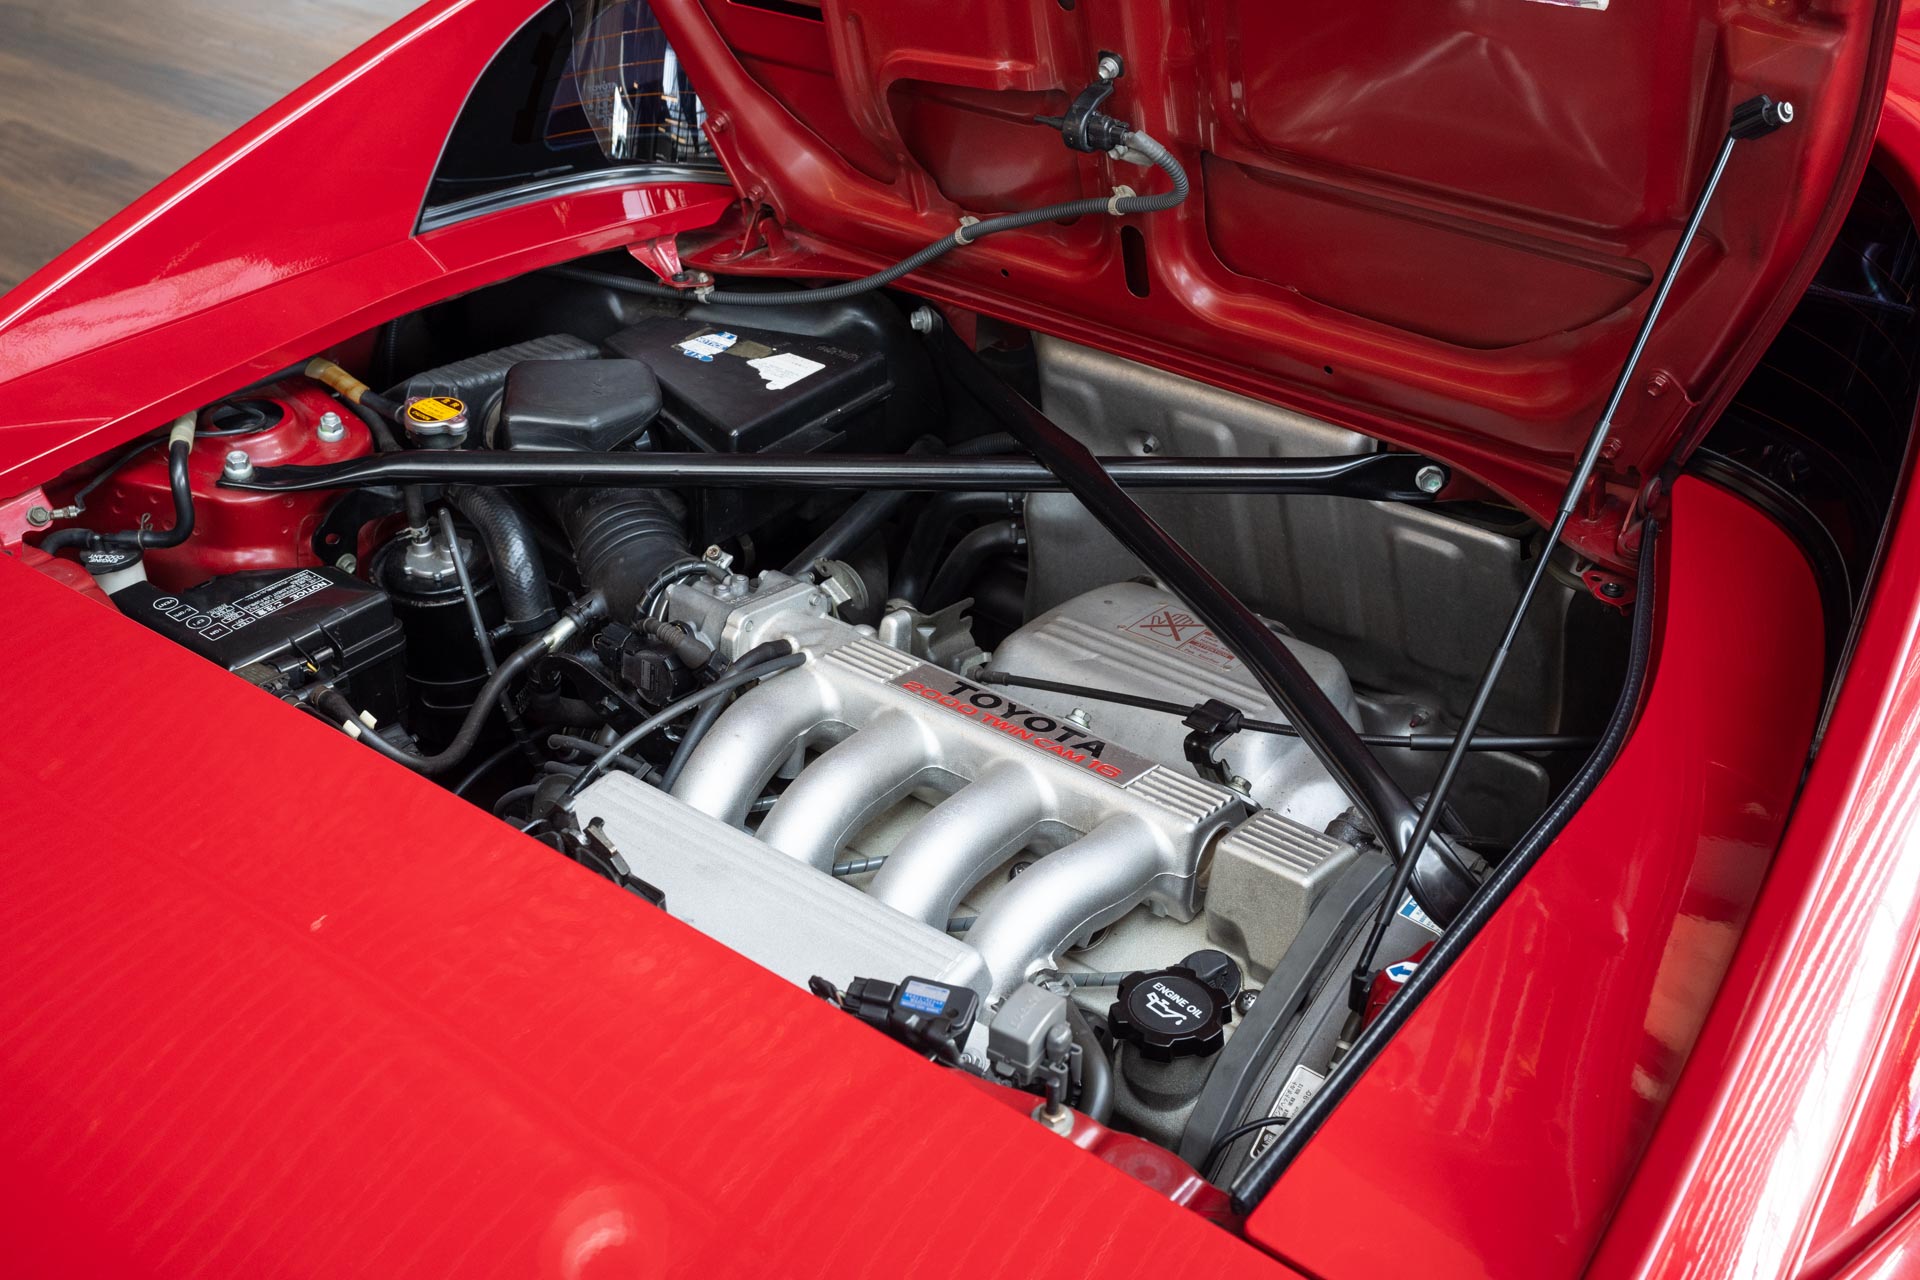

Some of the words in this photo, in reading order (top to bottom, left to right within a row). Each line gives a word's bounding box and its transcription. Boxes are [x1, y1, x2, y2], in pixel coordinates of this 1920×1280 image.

[290, 580, 328, 601] NOTICE
[902, 680, 978, 716] 2000
[983, 714, 1035, 740] TWIN
[1033, 737, 1086, 763] CAM
[1087, 758, 1124, 779] 16
[948, 680, 1106, 758] TOYOTA
[1152, 982, 1190, 1008] ENGINE
[1186, 1005, 1203, 1019] OIL
